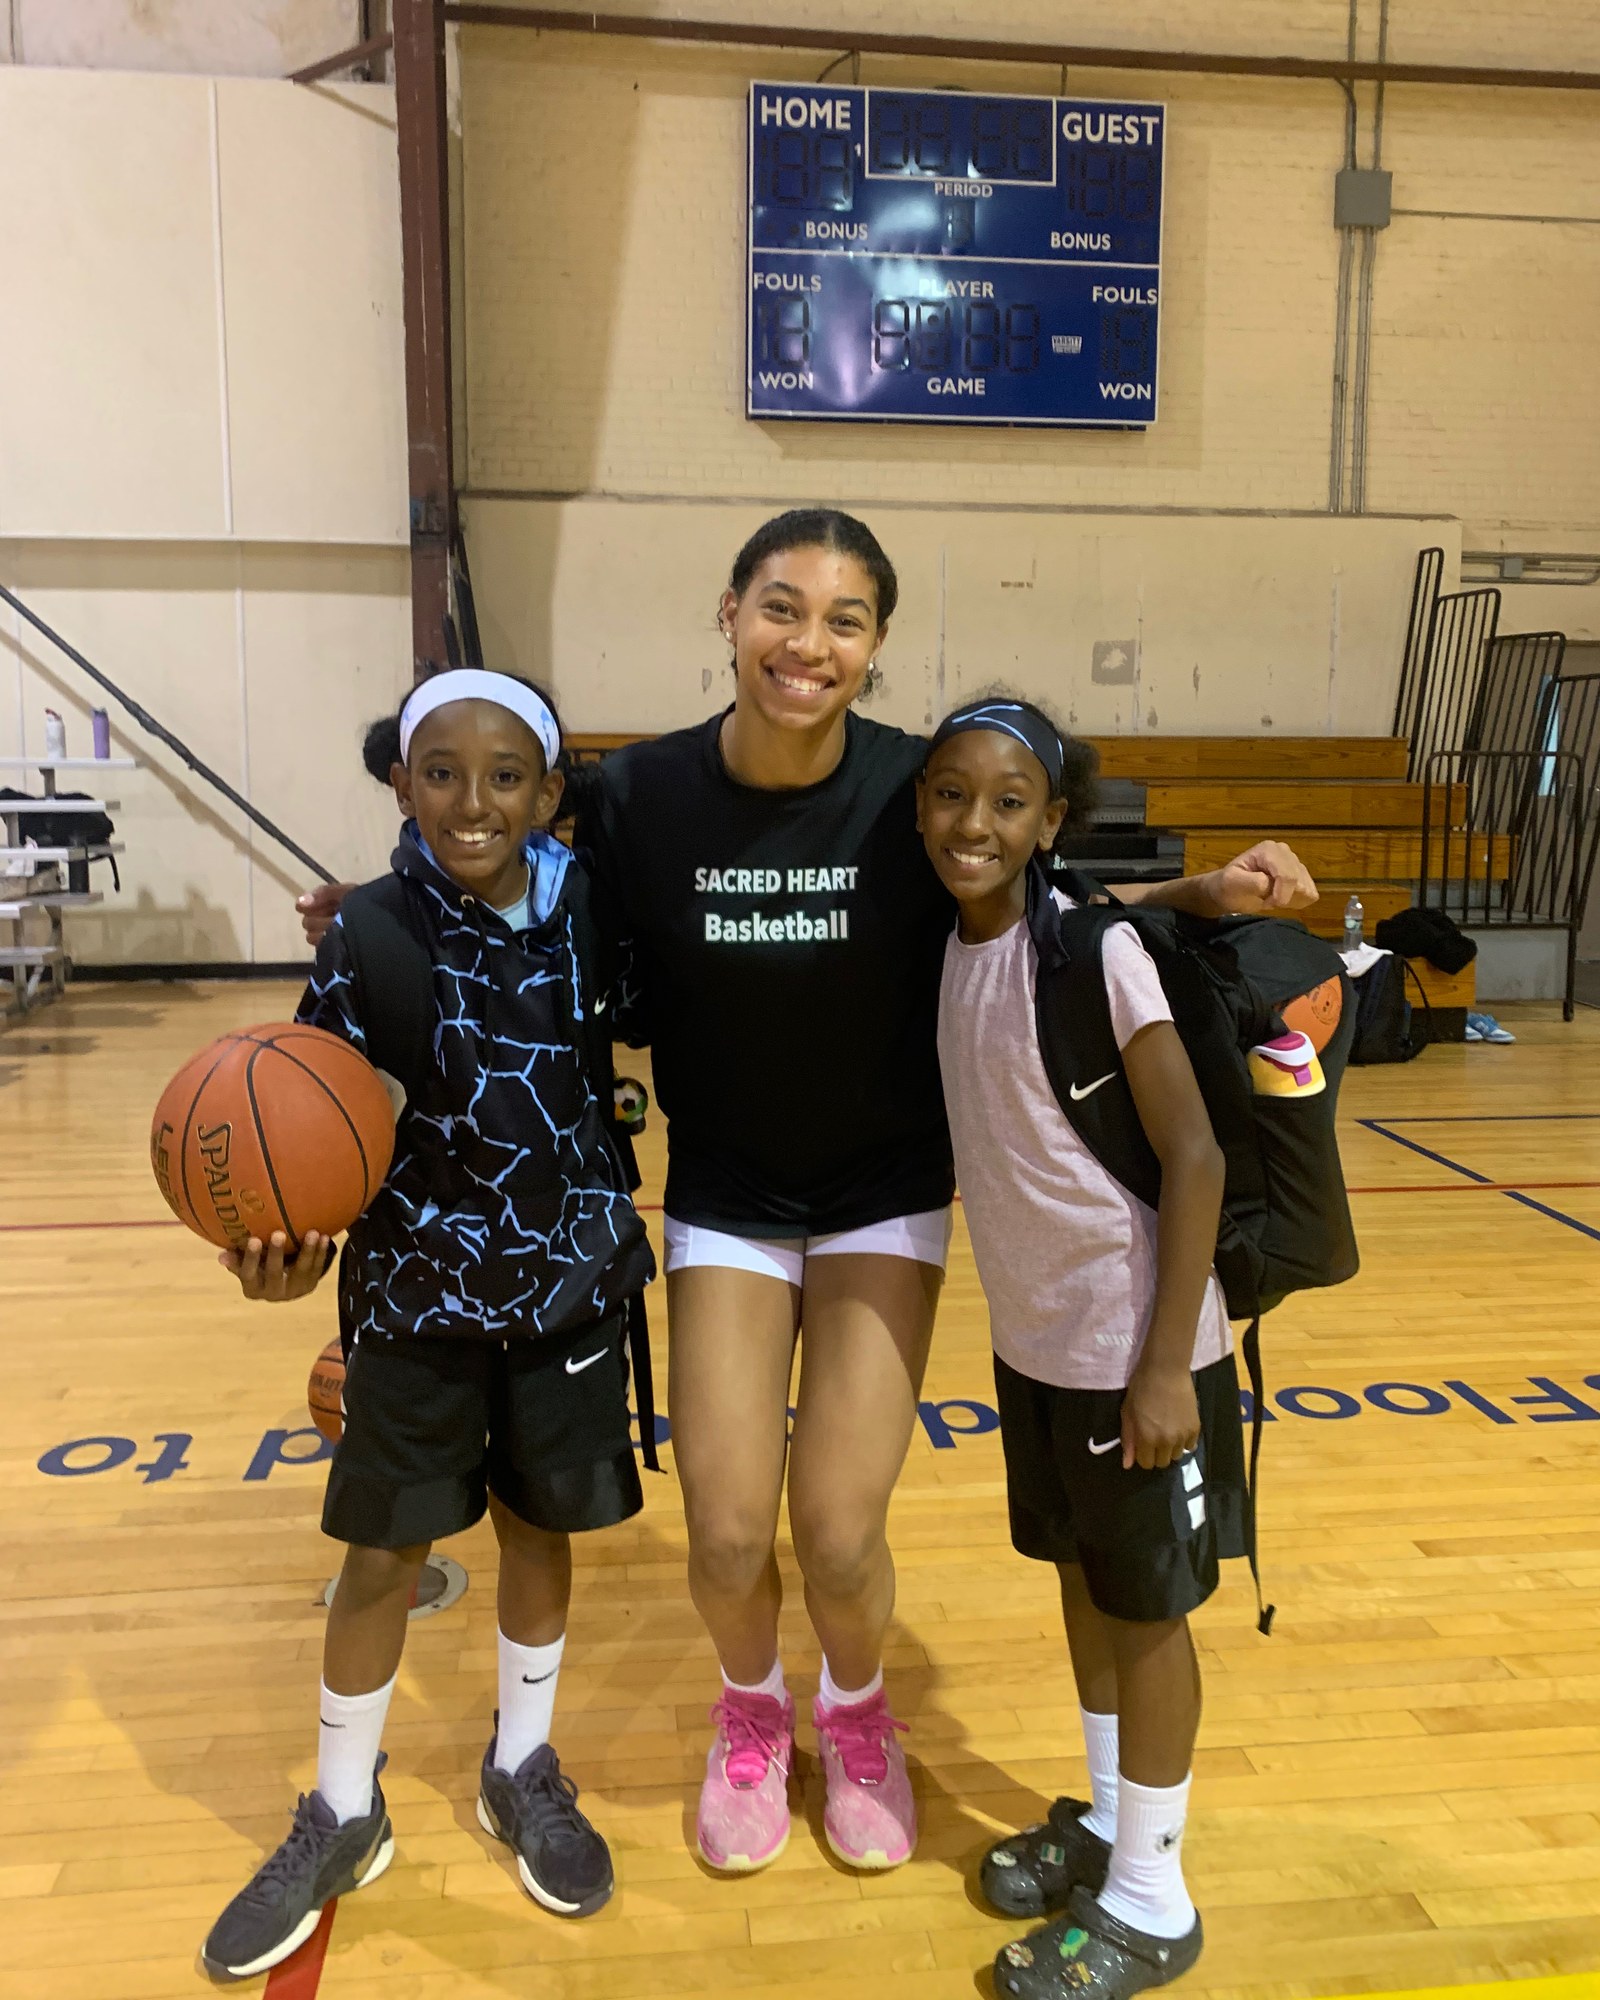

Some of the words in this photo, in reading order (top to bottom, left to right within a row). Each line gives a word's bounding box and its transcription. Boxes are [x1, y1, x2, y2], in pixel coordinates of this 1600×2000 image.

[761, 96, 851, 131] HOME
[1062, 112, 1159, 146] GUEST
[934, 182, 993, 198] PERIOD
[805, 221, 868, 240] BONUS
[1050, 232, 1111, 251] BONUS
[753, 272, 822, 292] FOULS
[918, 278, 994, 299] PLAYER
[1092, 286, 1158, 305] FOULS
[759, 372, 814, 390] WON
[927, 378, 985, 396] GAME
[1099, 382, 1152, 400] WON
[694, 867, 781, 893] SACRED
[787, 867, 859, 892] HEART
[705, 909, 848, 942] Basketball
[37, 1433, 193, 1484] to
